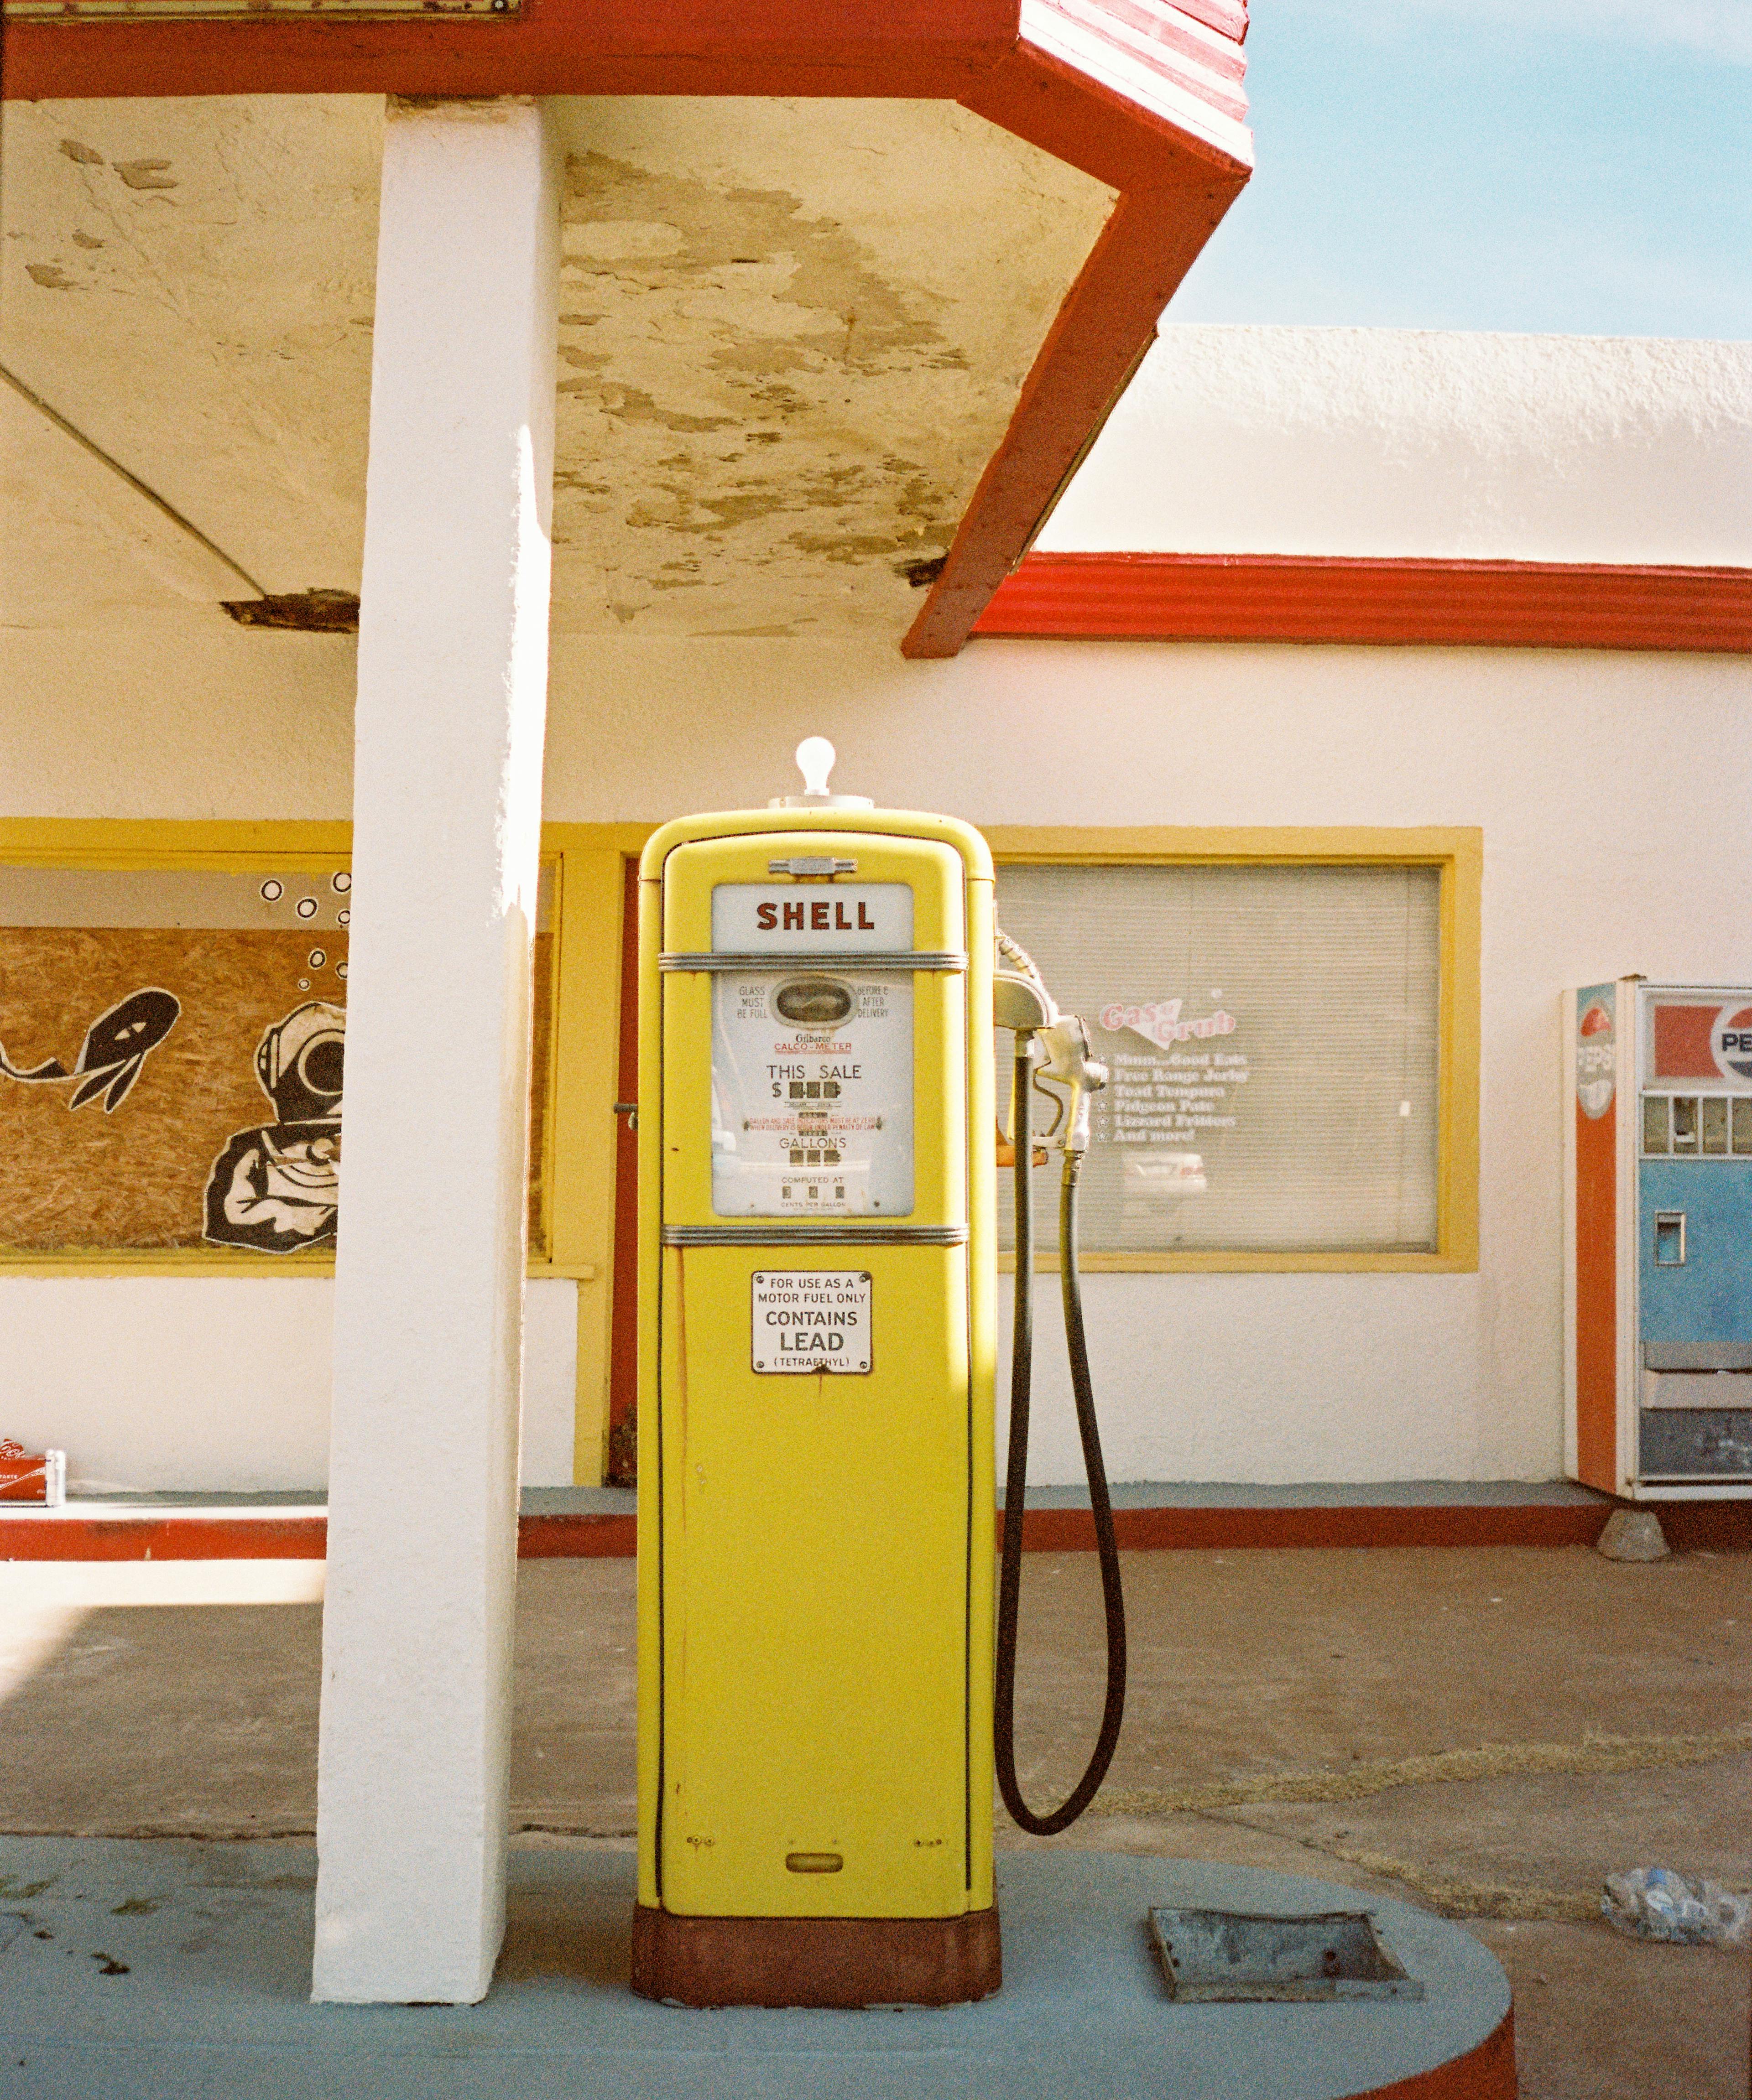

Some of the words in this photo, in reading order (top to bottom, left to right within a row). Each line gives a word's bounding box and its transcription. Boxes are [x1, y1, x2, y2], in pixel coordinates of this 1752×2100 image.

[756, 901, 875, 930] SHELL
[739, 986, 766, 995] GLASS
[858, 986, 881, 995] BEFORE
[742, 998, 764, 1007] MUST
[863, 997, 884, 1007] AFTER
[737, 1009, 746, 1019] BE
[750, 1009, 767, 1019] FULL
[858, 1008, 888, 1018] DELIVERY
[1100, 1003, 1157, 1031] Gas
[1153, 1010, 1236, 1042] Grub
[796, 1034, 830, 1043] Gilbarco
[1214, 1054, 1247, 1066] Eats
[766, 1065, 805, 1079] THIS
[819, 1065, 861, 1079] SALE
[1114, 1069, 1149, 1081] Free
[1152, 1069, 1200, 1084] Range
[1204, 1069, 1249, 1083] Jerky
[772, 1081, 782, 1098] $
[1114, 1084, 1152, 1097] Toad
[1156, 1084, 1225, 1099] Tempura
[1176, 1113, 1236, 1127] Fritters
[1114, 1128, 1147, 1141] And
[779, 1137, 847, 1149] GALLONS
[770, 1279, 793, 1288] FOR
[799, 1279, 821, 1288] USE
[824, 1279, 840, 1288] AS
[845, 1279, 854, 1288] A
[758, 1293, 799, 1303] MOTOR
[804, 1293, 833, 1303] FUEL
[837, 1293, 866, 1303] ONLY
[766, 1311, 858, 1325] CONTAINS
[780, 1332, 844, 1351] LEAD
